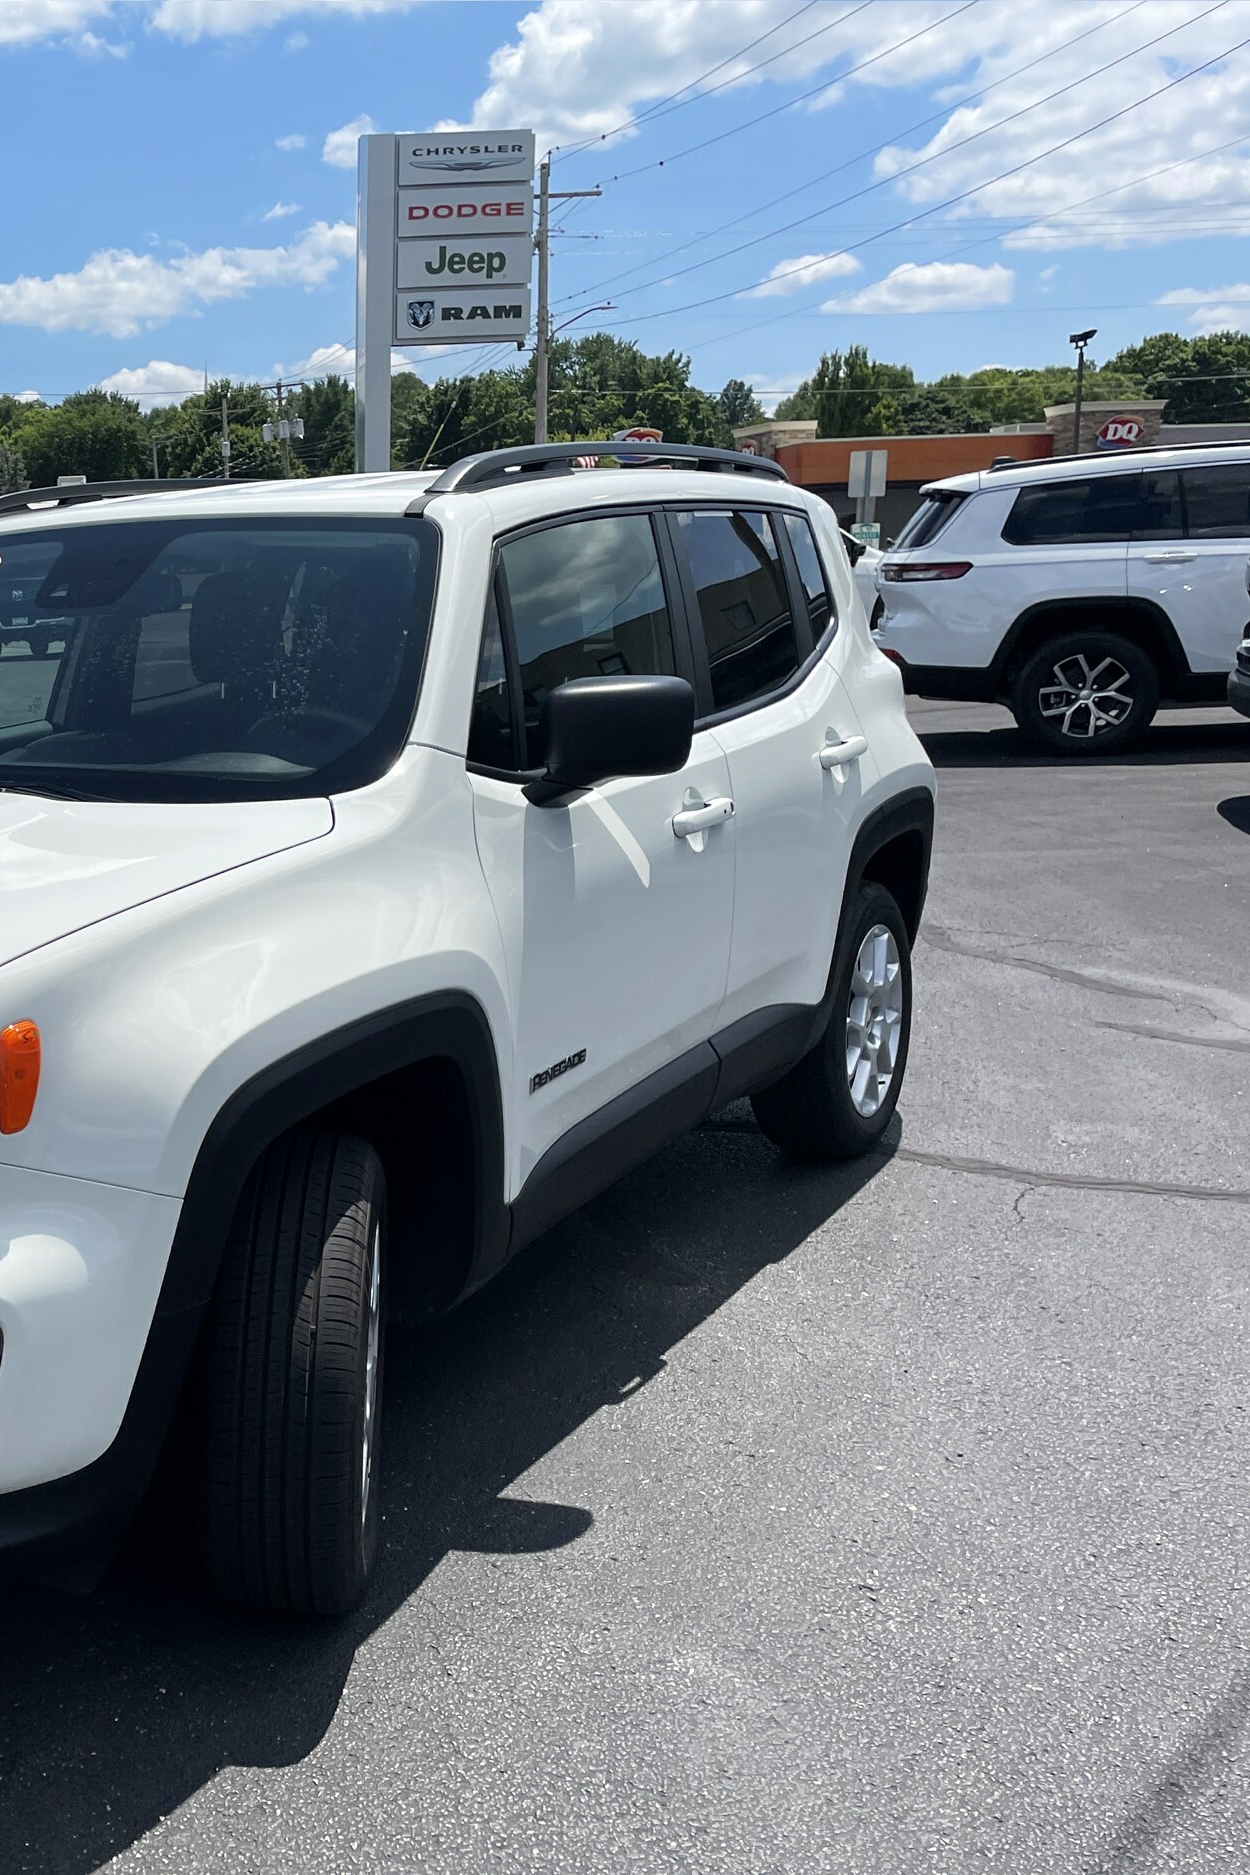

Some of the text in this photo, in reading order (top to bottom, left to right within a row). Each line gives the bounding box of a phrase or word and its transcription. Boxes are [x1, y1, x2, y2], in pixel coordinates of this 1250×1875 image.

[412, 145, 523, 157] CHRYSLER
[407, 202, 525, 220] DODGE
[424, 245, 506, 279] Jeep
[441, 304, 522, 321] RAM
[1105, 422, 1139, 441] DQ
[528, 1047, 587, 1097] RENEGADE
